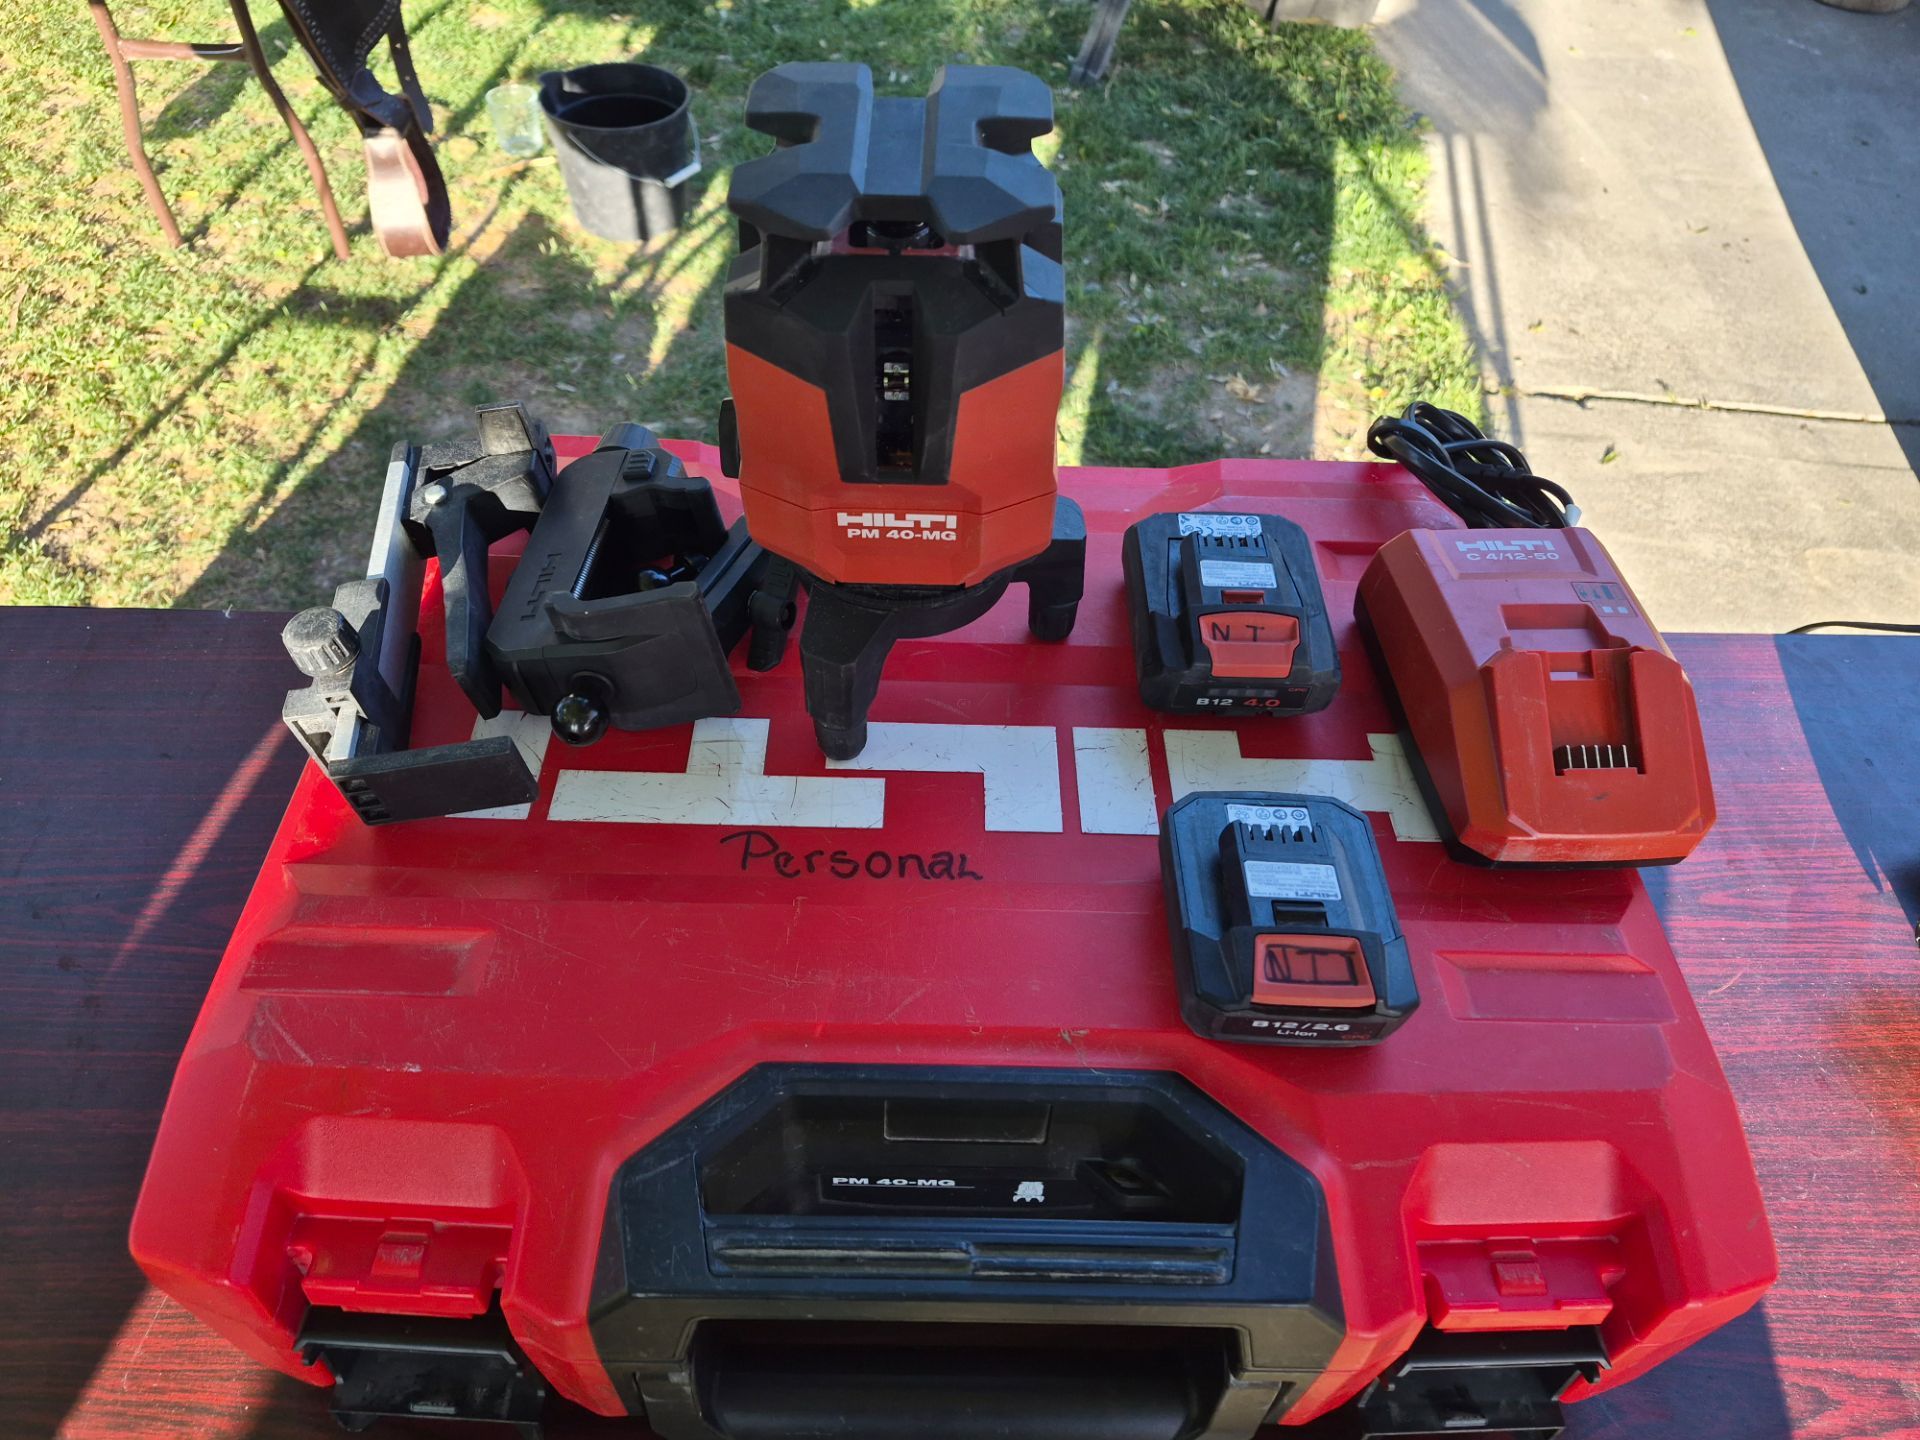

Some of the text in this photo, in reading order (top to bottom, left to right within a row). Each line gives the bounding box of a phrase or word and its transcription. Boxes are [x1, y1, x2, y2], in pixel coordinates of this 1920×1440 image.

[837, 512, 957, 529] HILTI
[847, 529, 956, 541] PM 40-MG
[1456, 540, 1555, 552] HILTI
[1196, 697, 1281, 708] B12 4.0
[1252, 1020, 1350, 1031] B12/2.6
[832, 1177, 956, 1187] PM 40-MG
